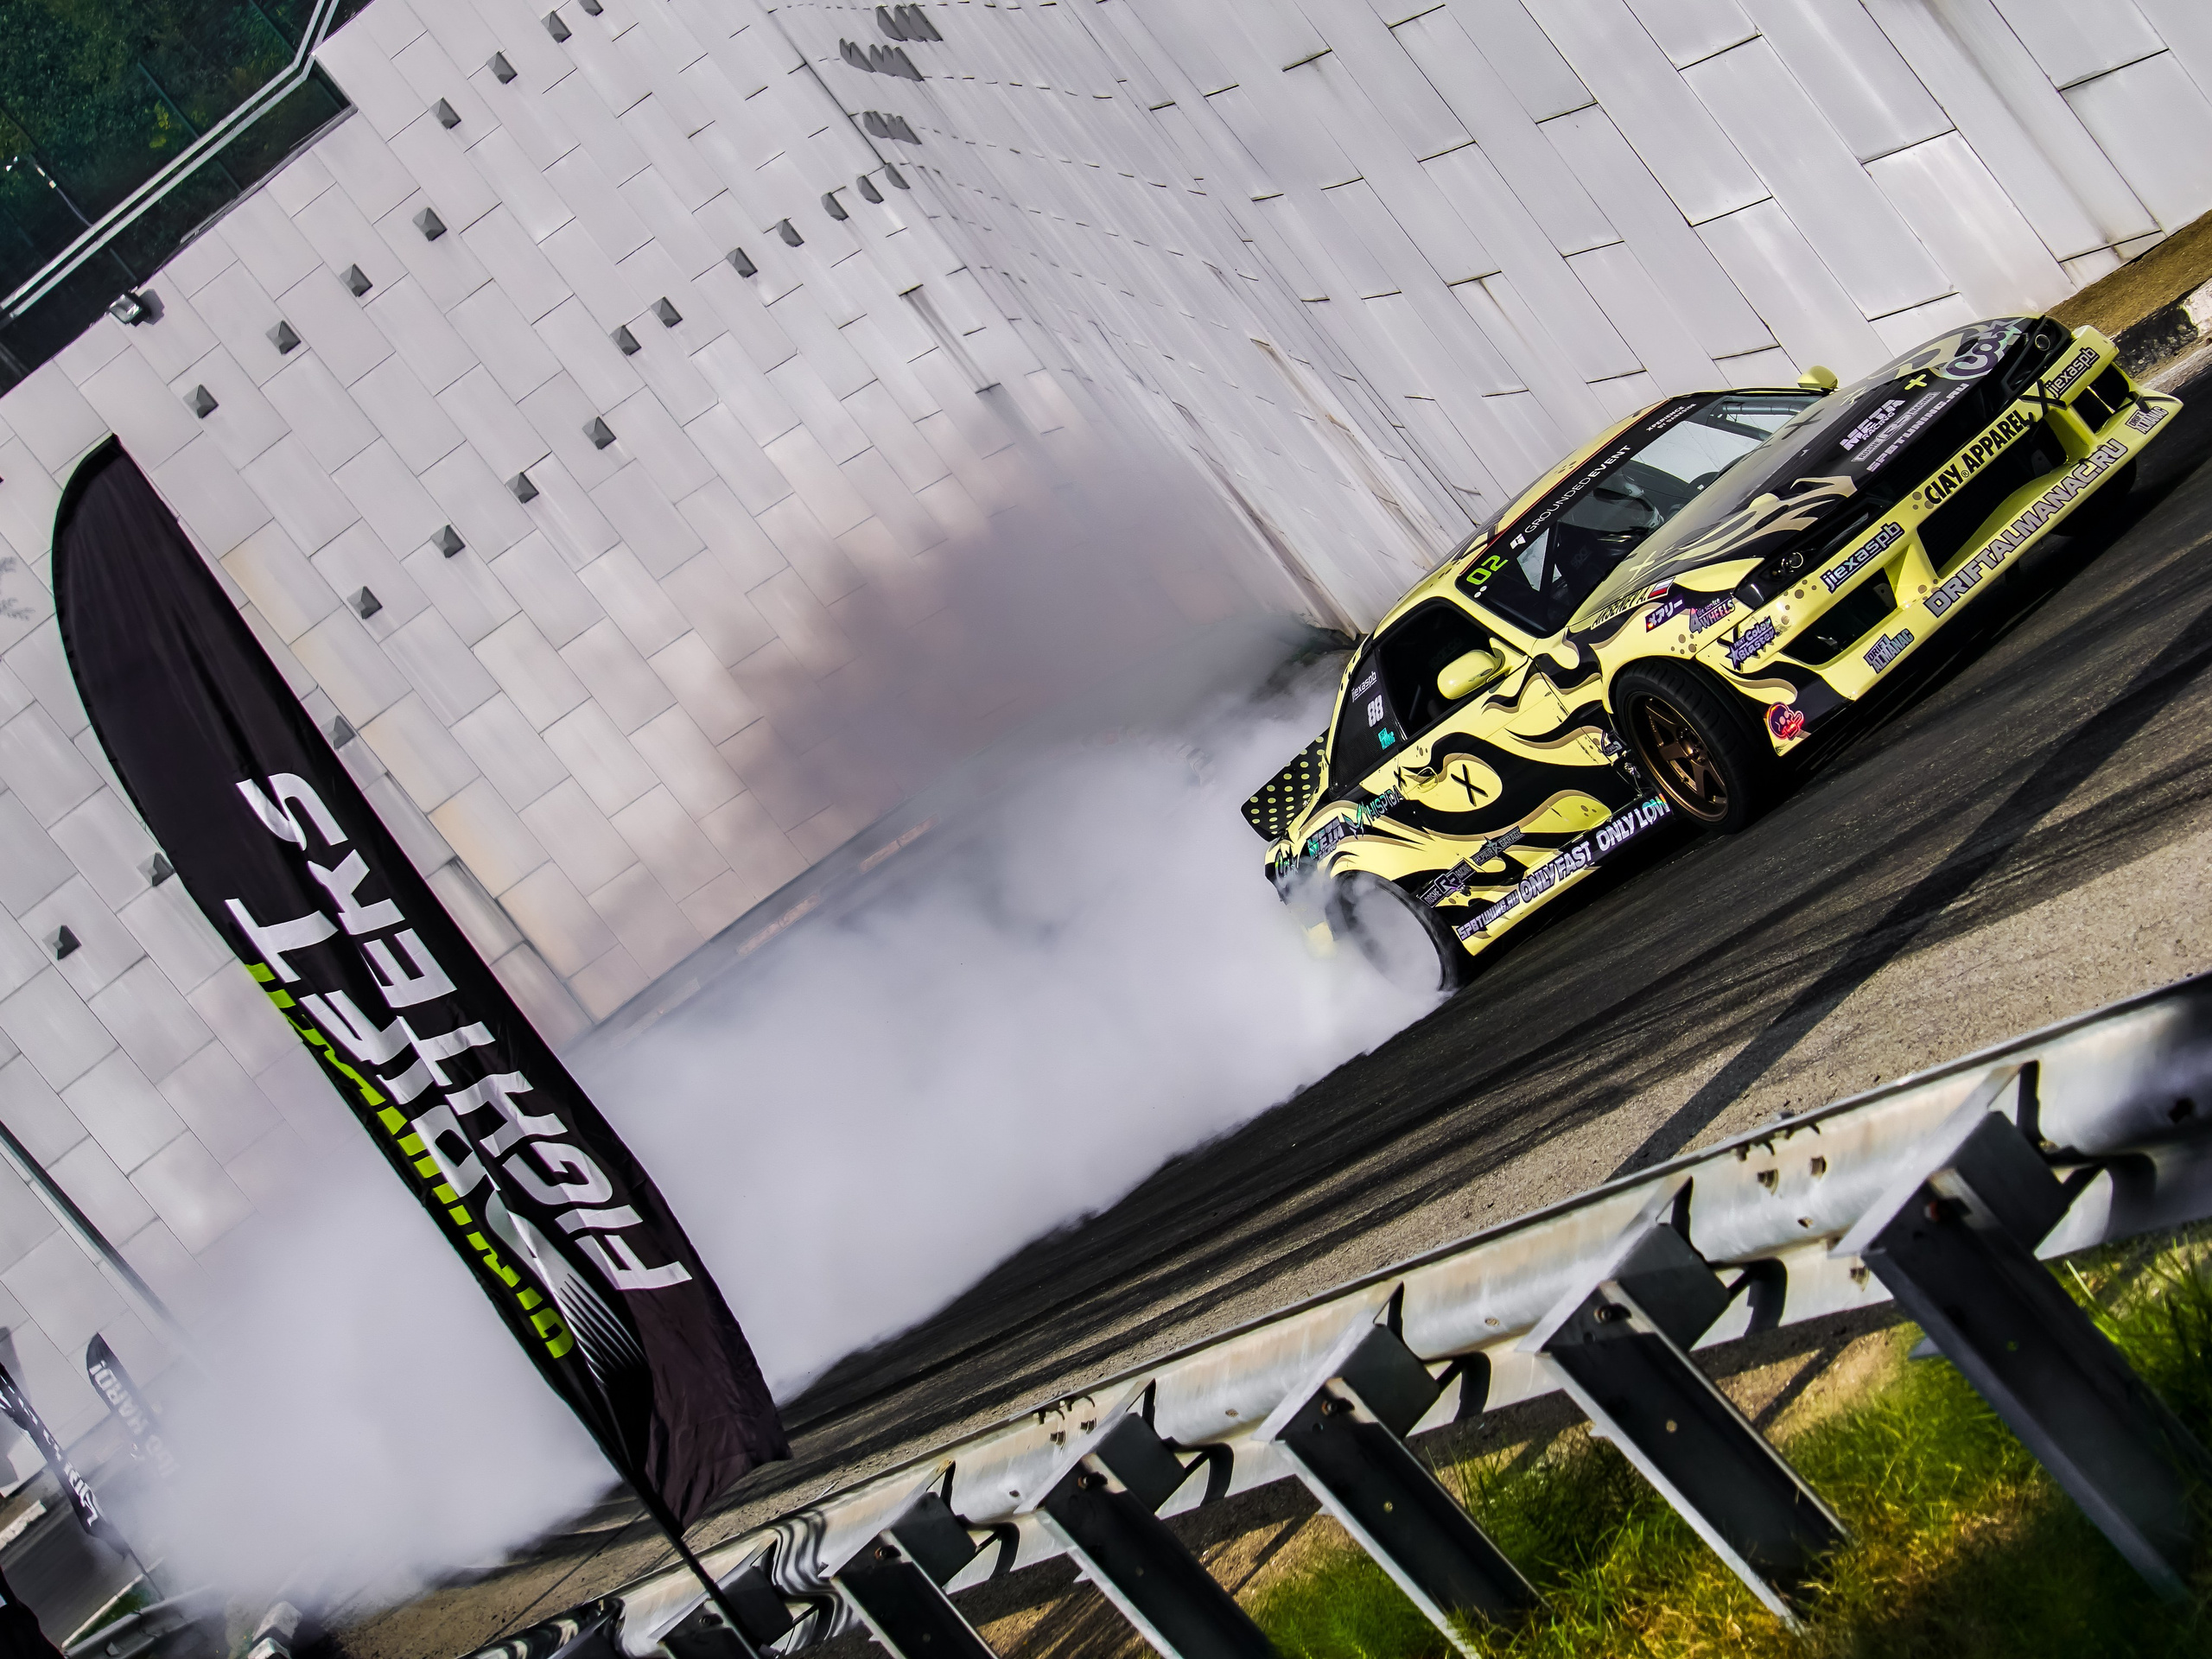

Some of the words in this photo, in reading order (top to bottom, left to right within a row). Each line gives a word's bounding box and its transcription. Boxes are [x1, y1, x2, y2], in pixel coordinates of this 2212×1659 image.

[2044, 345, 2101, 402] jiexaspb
[1839, 399, 1905, 451] META
[1524, 445, 1631, 533] GROUNDEDEVENT
[1926, 435, 2128, 618] DRIFTALMANAC.RU
[1466, 555, 1509, 586] 02
[1821, 518, 1905, 592] jiexaspb
[1699, 599, 1735, 628] WHEELS
[1744, 618, 1770, 641] Color
[1737, 628, 1774, 660] Blaster
[1866, 637, 1888, 661] DRIFT
[1871, 628, 1914, 673] ALMANAC
[1366, 694, 1384, 727] 88
[1517, 860, 1554, 903] ONLY
[1554, 840, 1593, 880] FAST
[1593, 810, 1632, 852] ONLY
